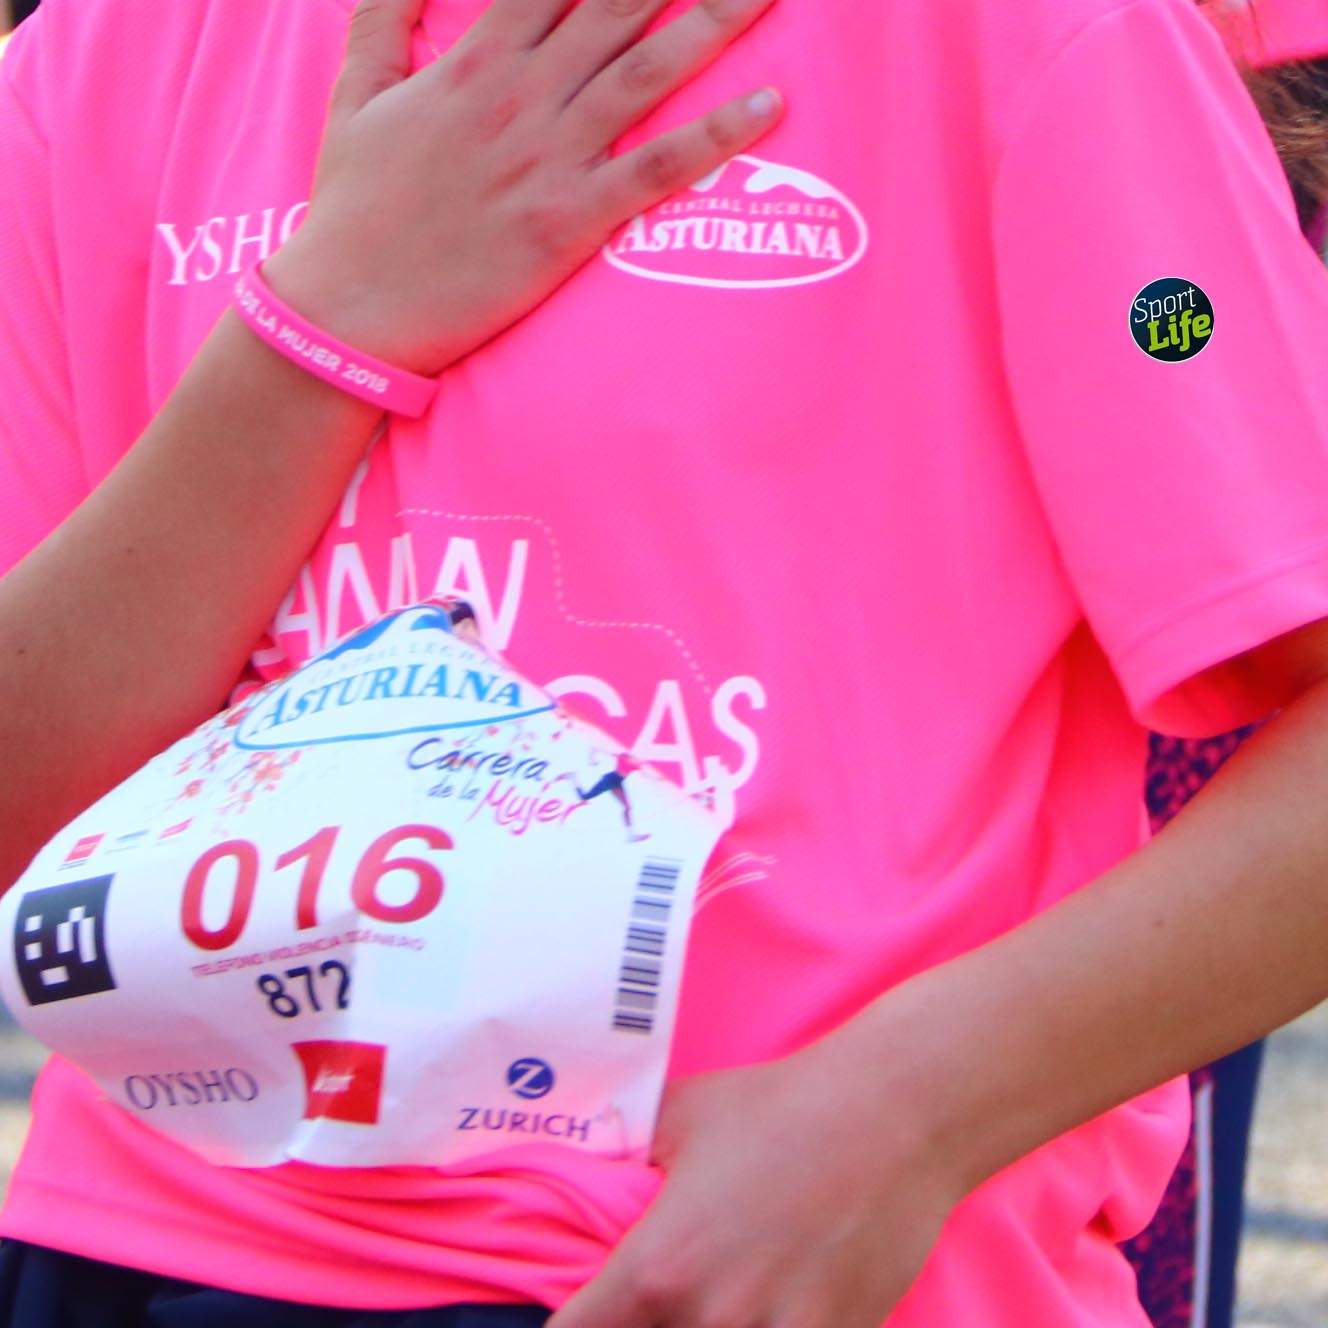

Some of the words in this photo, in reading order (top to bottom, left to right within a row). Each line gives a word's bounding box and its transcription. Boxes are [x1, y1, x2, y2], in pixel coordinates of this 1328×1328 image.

[614, 215, 845, 261] ASTURIANA
[276, 324, 343, 372] MUJER
[264, 663, 524, 730] ASTURIANA
[406, 737, 549, 781] Carrera
[427, 775, 453, 799] de
[458, 777, 480, 801] la
[467, 777, 590, 836] Mujer
[179, 823, 456, 952] 016
[124, 1067, 259, 1110] OYSHO
[456, 1107, 591, 1142] ZURICH
